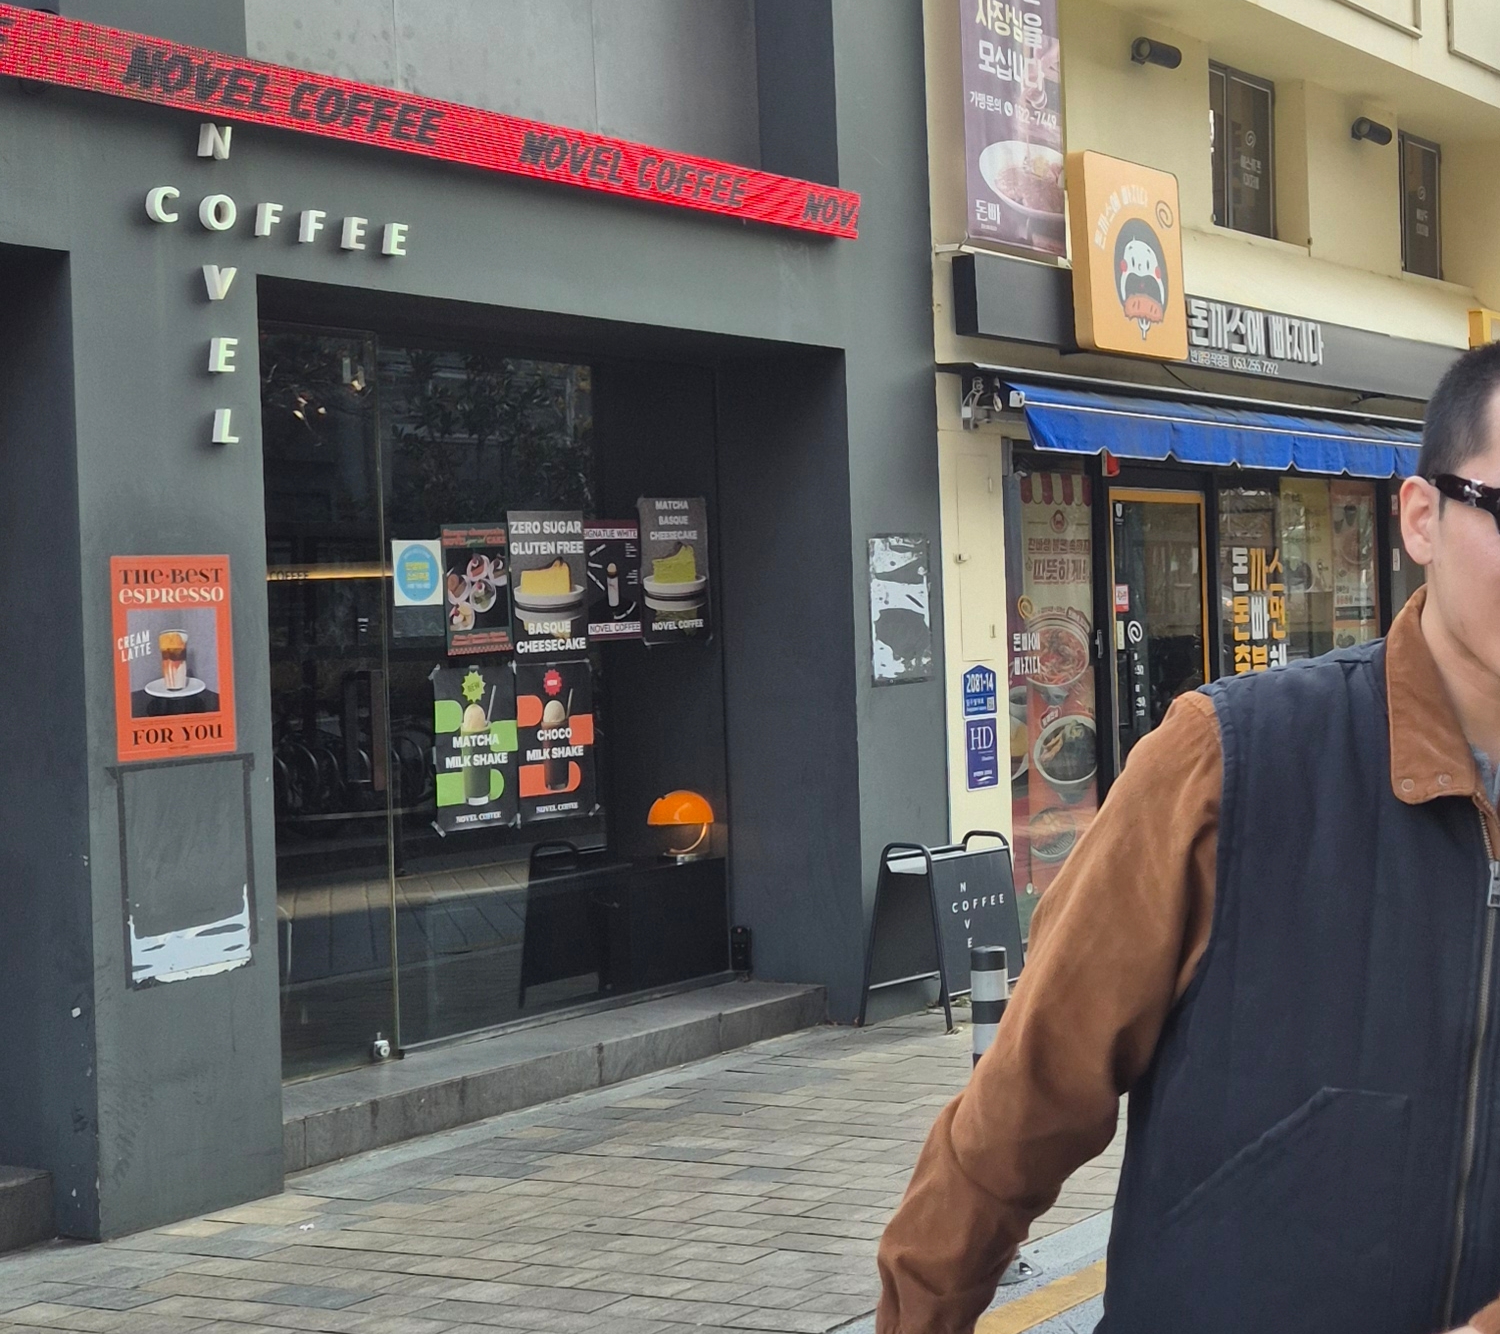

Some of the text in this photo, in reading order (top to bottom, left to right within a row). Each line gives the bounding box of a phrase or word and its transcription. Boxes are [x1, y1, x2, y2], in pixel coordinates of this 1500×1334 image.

[978, 39, 1045, 92] 모십니다
[122, 46, 446, 146] NOVEL COFFEE
[970, 91, 1001, 114] 가맹문의
[518, 131, 749, 208] NOVEL COFFEE
[802, 192, 859, 230] NOV
[975, 199, 1001, 225] 돈빠
[145, 186, 409, 256] COFFEE
[1188, 298, 1324, 366] 돈까스에 빠지다
[655, 500, 689, 511] MATCHA
[510, 521, 582, 535] ZERO SUGAR
[658, 516, 689, 526] BASQUE
[616, 529, 638, 538] WHITE
[649, 530, 698, 541] CHEESECAKE
[510, 541, 584, 555] GLUTEN FREE
[1232, 547, 1285, 592] 돈까스
[527, 620, 571, 635] BASQUE
[590, 623, 641, 634] NOVEL COFFEE
[652, 619, 704, 631] NOVEL COFFEE
[117, 629, 150, 650] CREAM
[516, 637, 587, 654] CHEESECAKE
[121, 642, 152, 663] LATTE
[966, 673, 994, 693] 2081-14
[132, 723, 223, 746] FOR YOU
[452, 733, 500, 749] MATCHA
[536, 727, 573, 742] CHOCO
[970, 726, 994, 751] HD
[445, 752, 508, 769] MILK SHAKE
[526, 745, 584, 762] MILK SHAKE
[535, 804, 557, 814] NOVEL
[952, 893, 1004, 913] COFFEE
